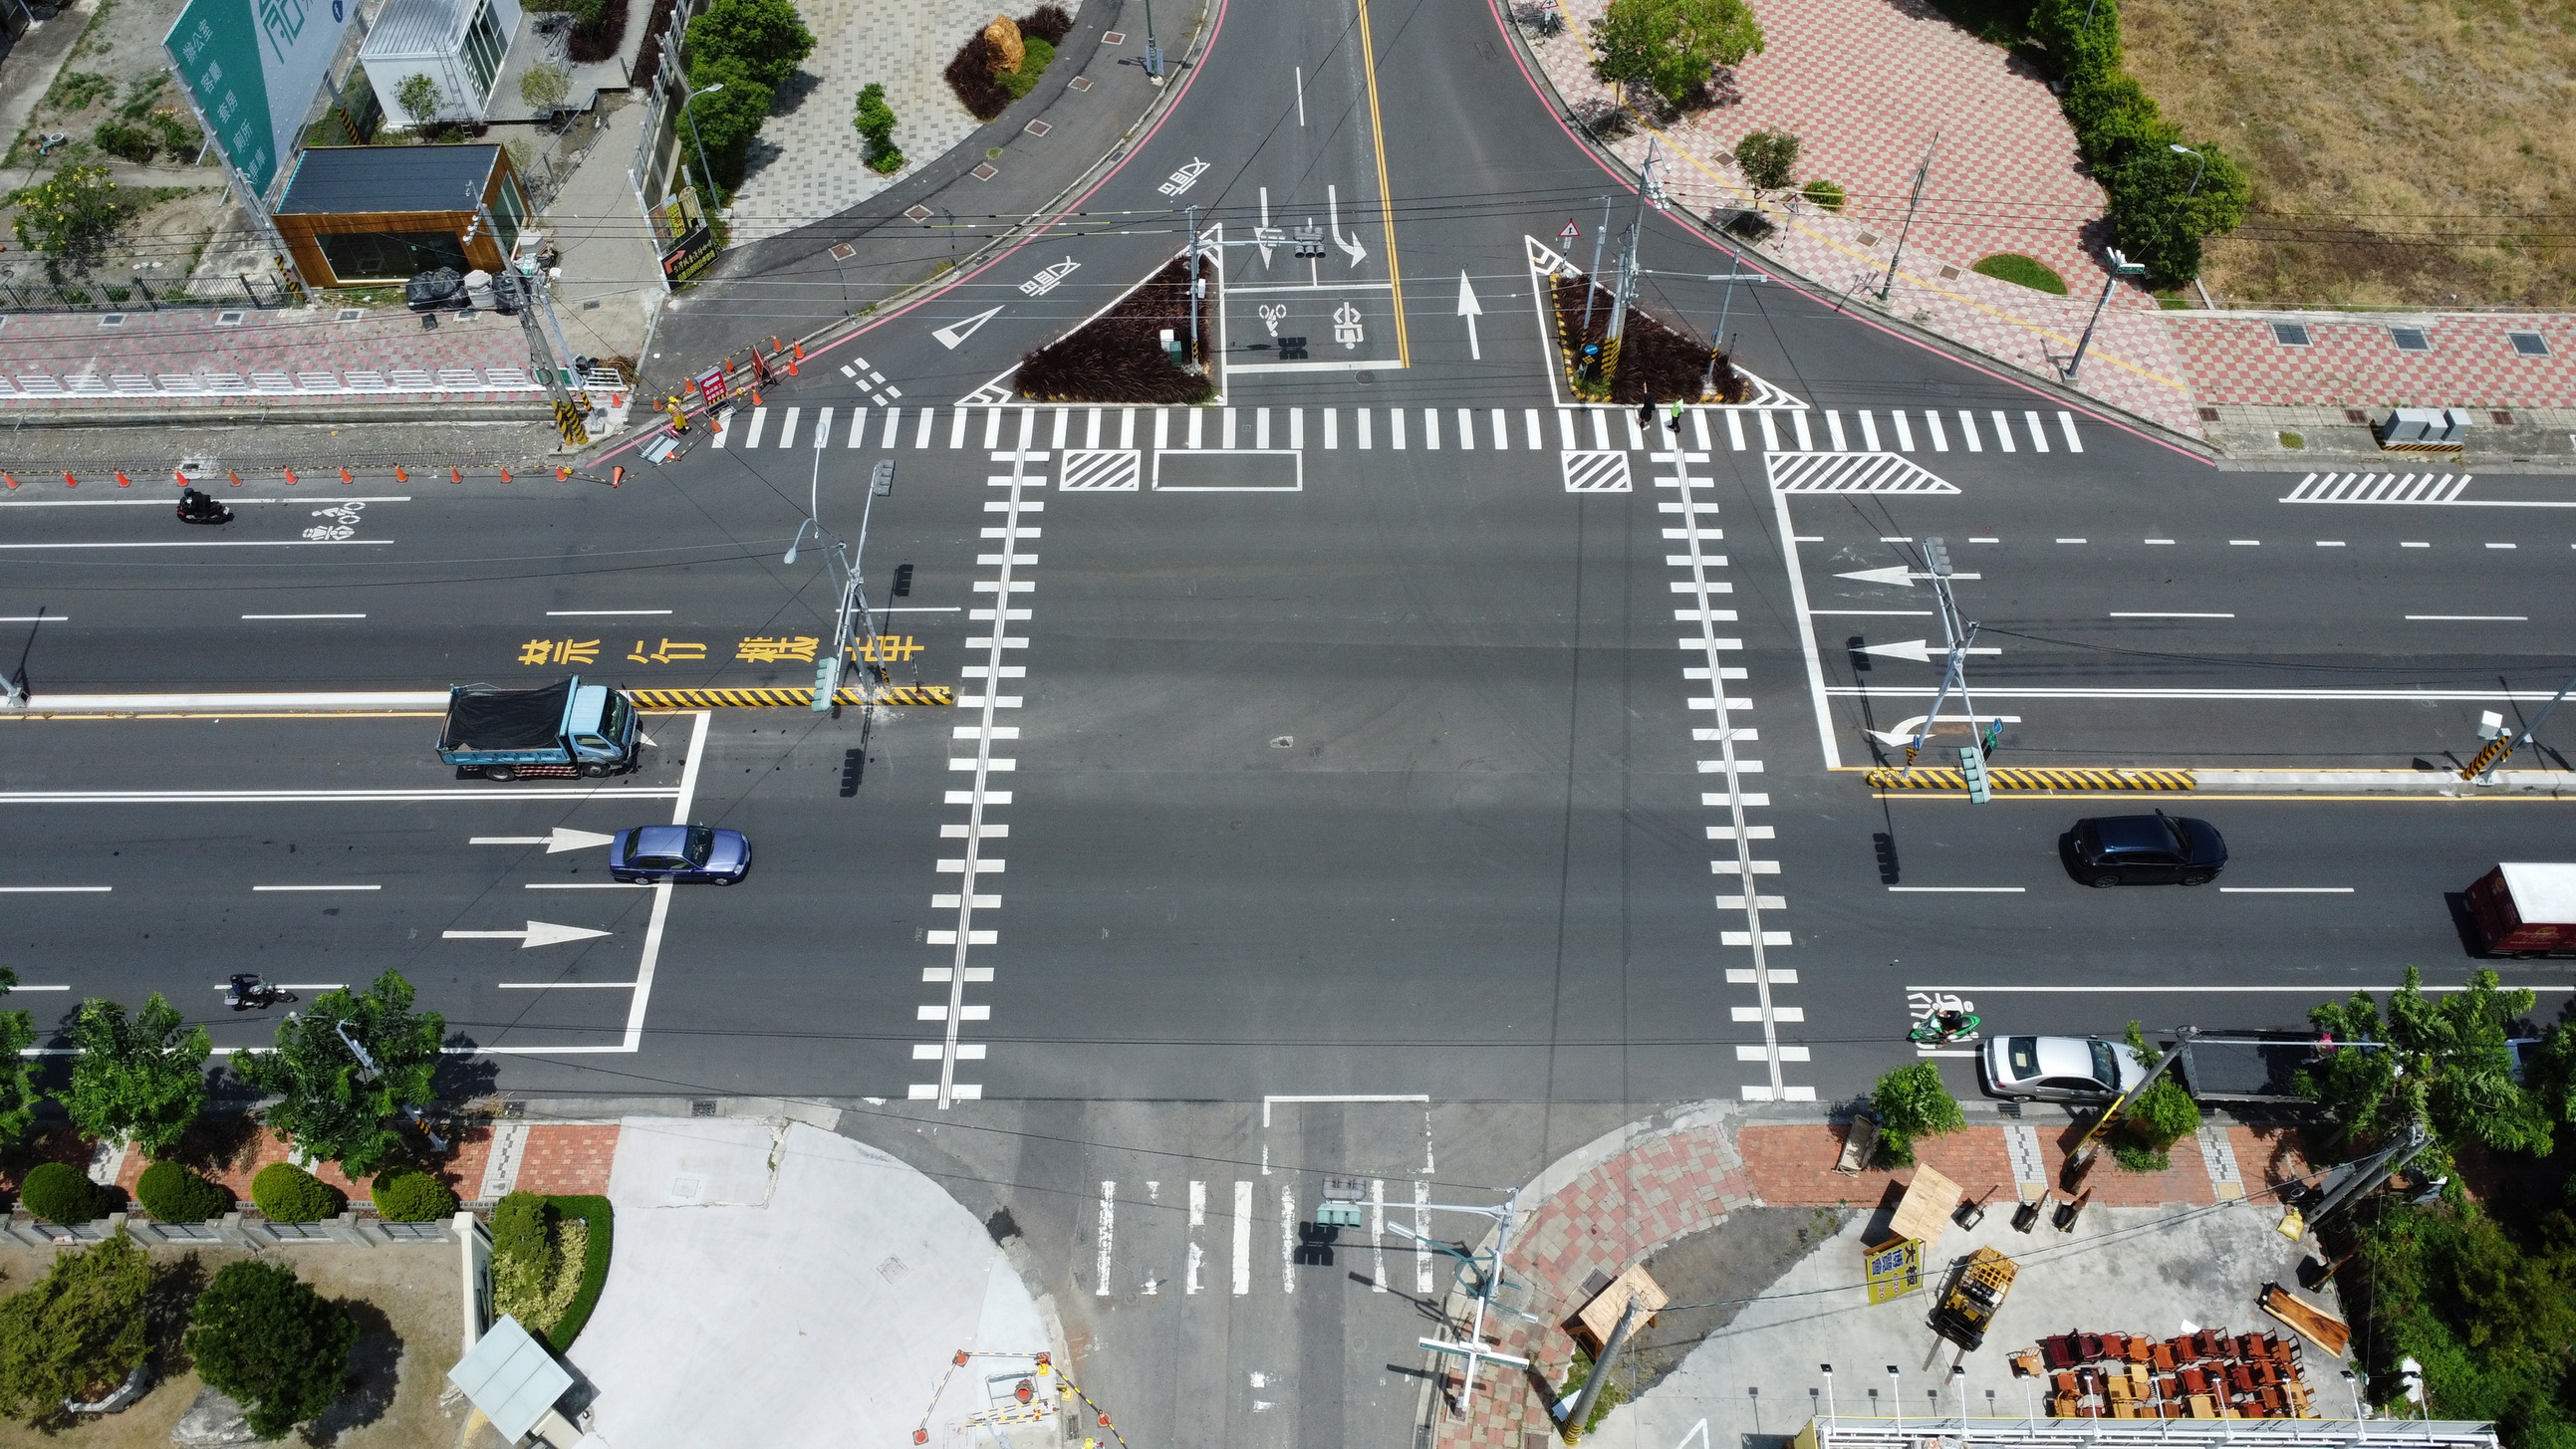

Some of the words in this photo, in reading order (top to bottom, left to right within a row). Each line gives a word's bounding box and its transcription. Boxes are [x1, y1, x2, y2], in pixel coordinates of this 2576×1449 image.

[182, 18, 213, 67] 辦公室
[200, 59, 223, 95] 客廳
[216, 89, 239, 124] 套房
[232, 118, 254, 154] 廁所
[1158, 156, 1211, 197] 慢
[1018, 255, 1082, 298] 慢
